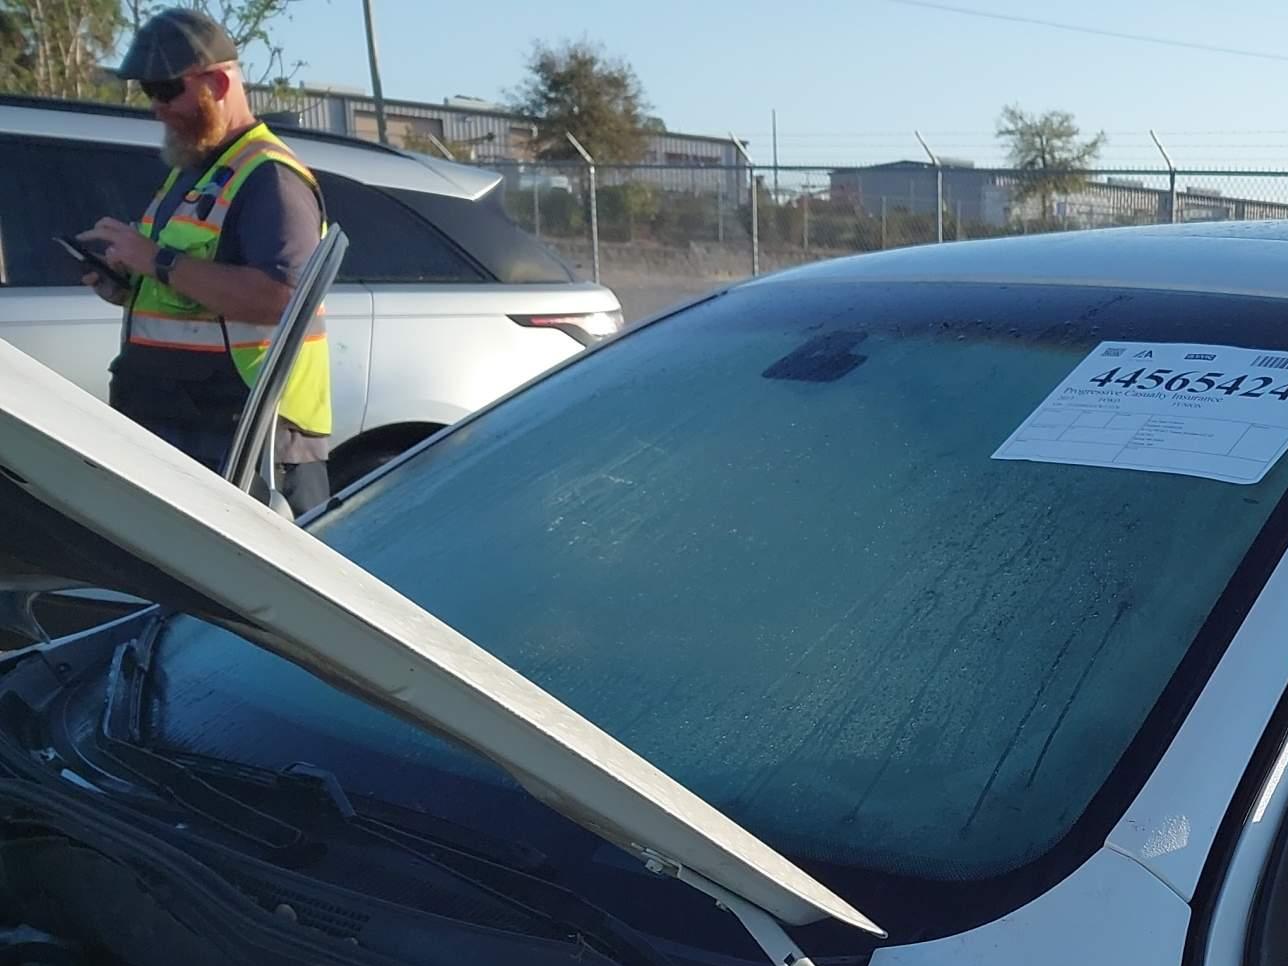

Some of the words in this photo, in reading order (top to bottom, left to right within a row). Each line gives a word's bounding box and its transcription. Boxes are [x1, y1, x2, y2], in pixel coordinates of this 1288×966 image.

[1063, 387, 1123, 397] Progressive
[1124, 390, 1167, 400] Casualty
[1171, 392, 1223, 403] Insurance
